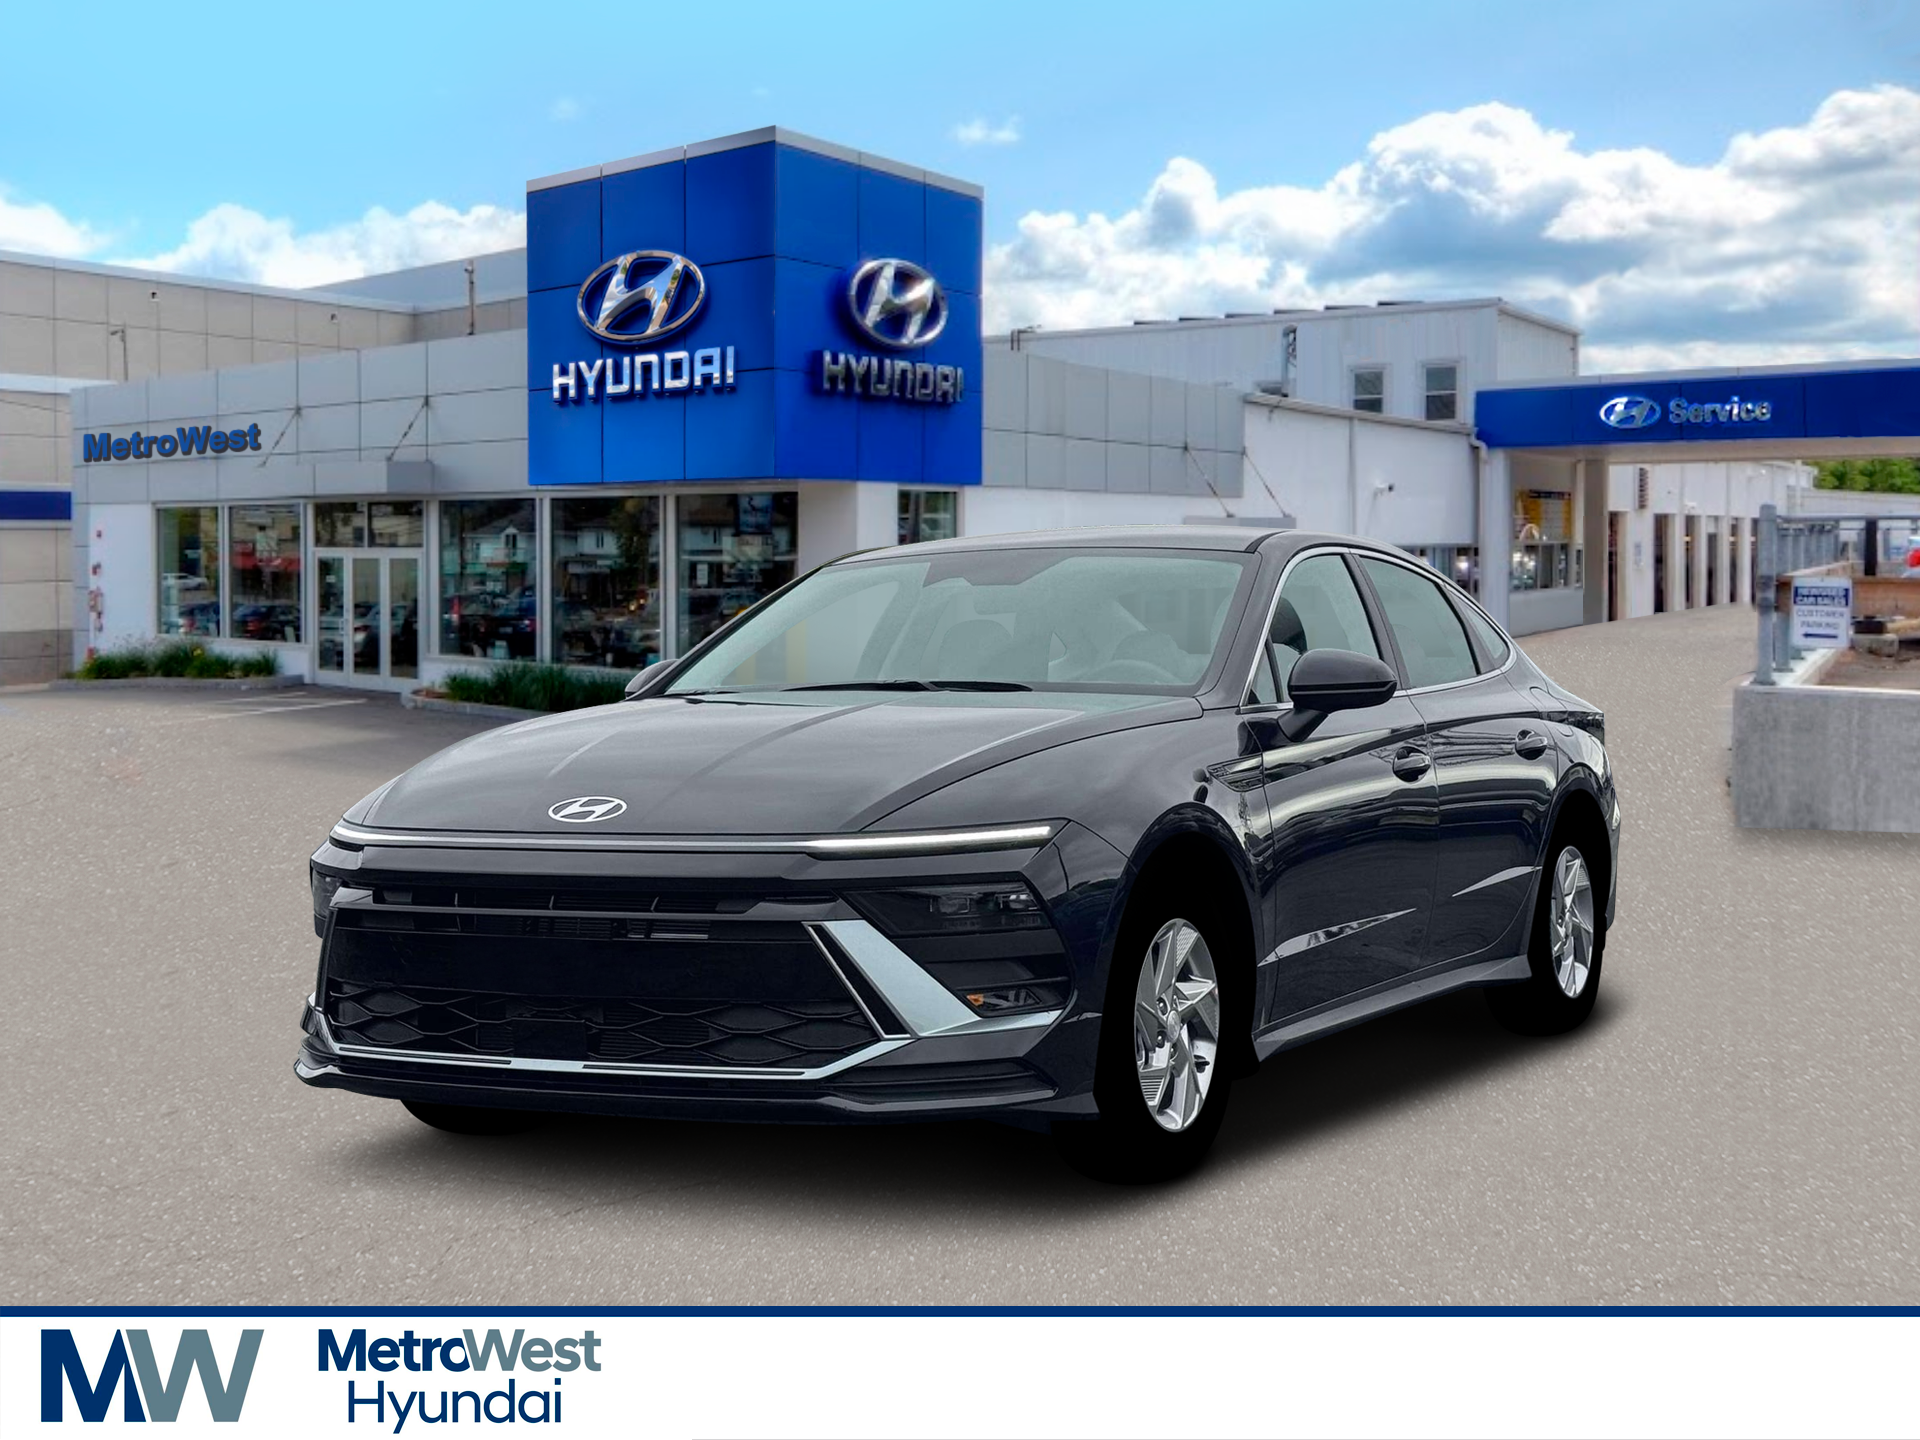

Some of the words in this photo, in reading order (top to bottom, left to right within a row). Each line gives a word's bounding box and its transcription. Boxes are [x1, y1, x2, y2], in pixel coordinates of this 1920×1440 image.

[552, 345, 736, 400] HYUNDAI
[822, 350, 965, 403] HYUNDAI
[1668, 396, 1772, 424] Service
[83, 423, 261, 462] MetroWest
[1796, 609, 1844, 619] CUSTOMER
